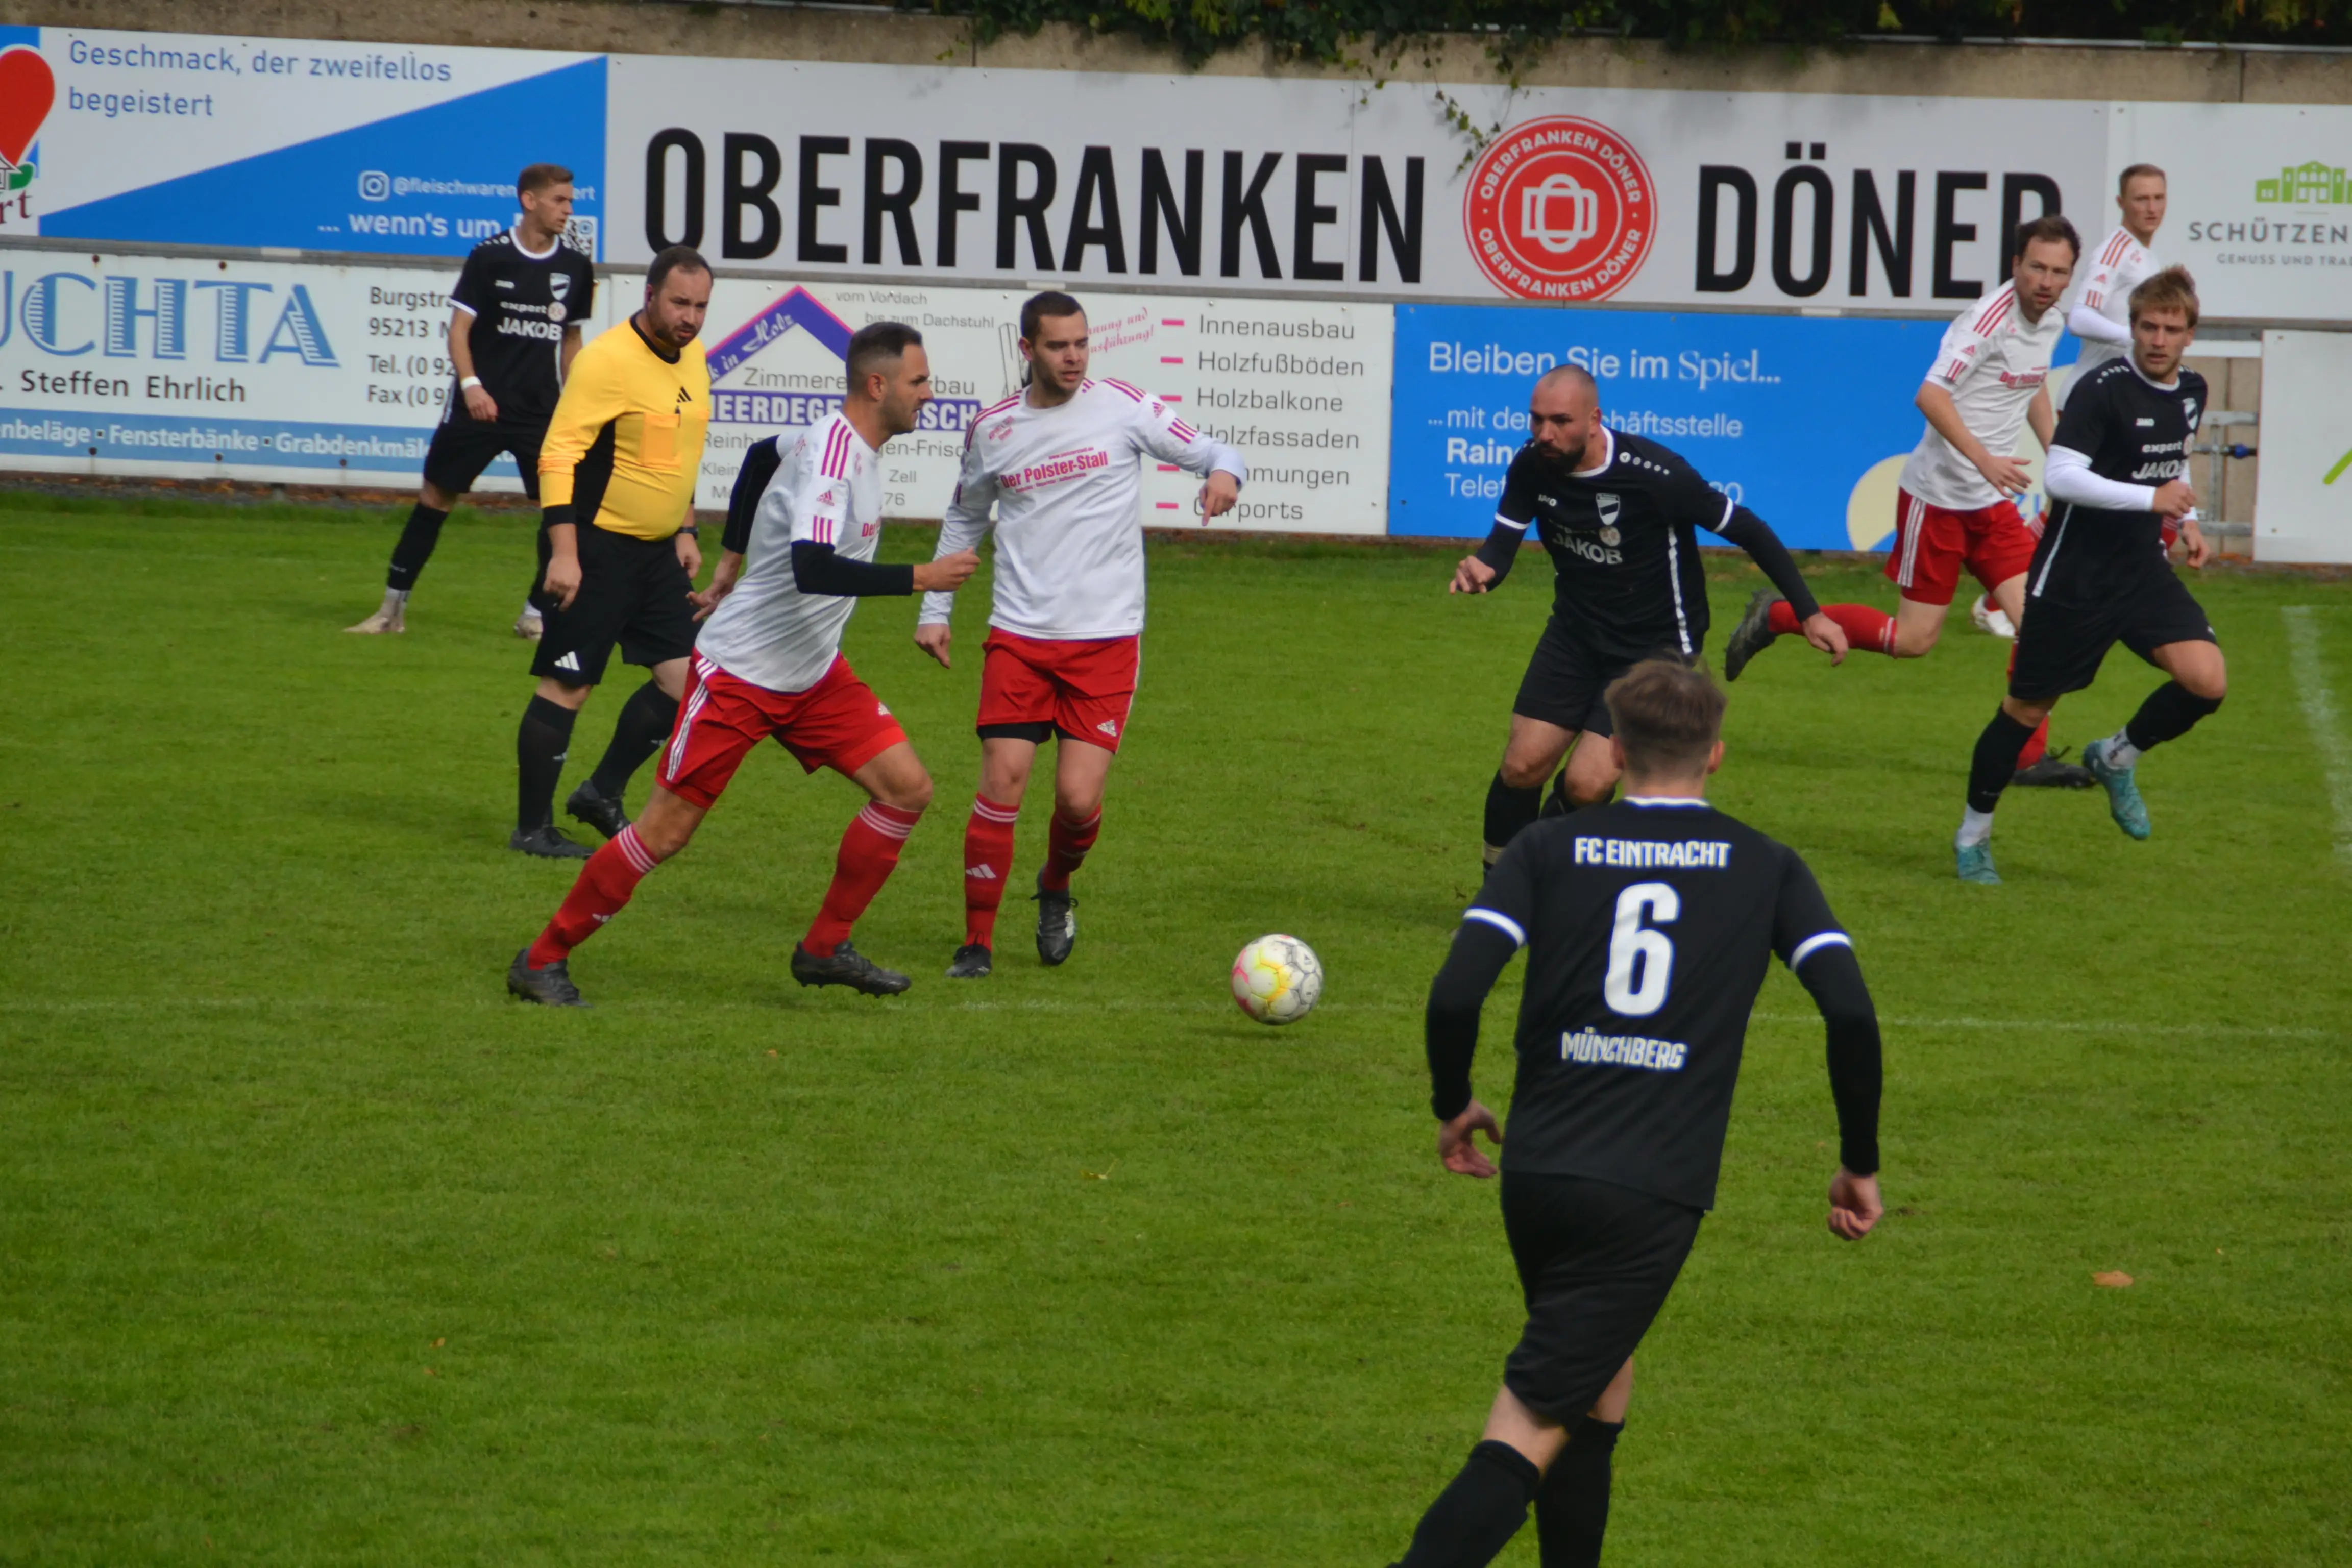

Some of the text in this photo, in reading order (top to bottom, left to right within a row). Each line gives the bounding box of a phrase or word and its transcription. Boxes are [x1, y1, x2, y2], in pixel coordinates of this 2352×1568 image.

[69, 40, 452, 82] Geschmack, der zweifellos
[69, 86, 213, 117] begeistert
[1480, 130, 1641, 203] OBERFRANKEN DÖNER
[645, 127, 1425, 284] OBERFRANKEN
[348, 212, 449, 237] wenn's
[456, 218, 501, 238] um
[1479, 227, 1642, 297] OBERFRANKEN DÖNER
[2216, 254, 2275, 266] GENUSS
[2281, 255, 2314, 266] UND
[836, 291, 865, 303] vom
[868, 289, 928, 305] Vordach
[369, 317, 429, 338] 95213
[496, 316, 563, 341] JAKOB
[923, 313, 994, 329] Dachstuhl
[1199, 314, 1355, 340] Innenausbau
[368, 355, 402, 374] Tel.
[1198, 350, 1364, 377] Holzfußböden
[1429, 341, 1556, 375] Bleiben
[1566, 346, 1621, 379] Sie
[1630, 349, 1668, 379] im
[21, 369, 246, 403] Steffen Ehrlich
[368, 384, 402, 404] Fax
[1197, 387, 1343, 412] Holzbalkone
[109, 424, 258, 452] Fensterbänke
[1197, 424, 1359, 449] Holzfassaden
[2142, 440, 2182, 454] expert
[1447, 437, 1523, 465] Rain
[888, 469, 917, 483] Zell
[999, 473, 1021, 489] Der
[1023, 451, 1109, 483] Polster-Stall
[1551, 532, 1623, 565] JAKOB
[1574, 837, 1732, 867] FC EINTRACHT
[1604, 881, 1680, 1016] 6
[1561, 1026, 1687, 1069] MÜNCHBERG
